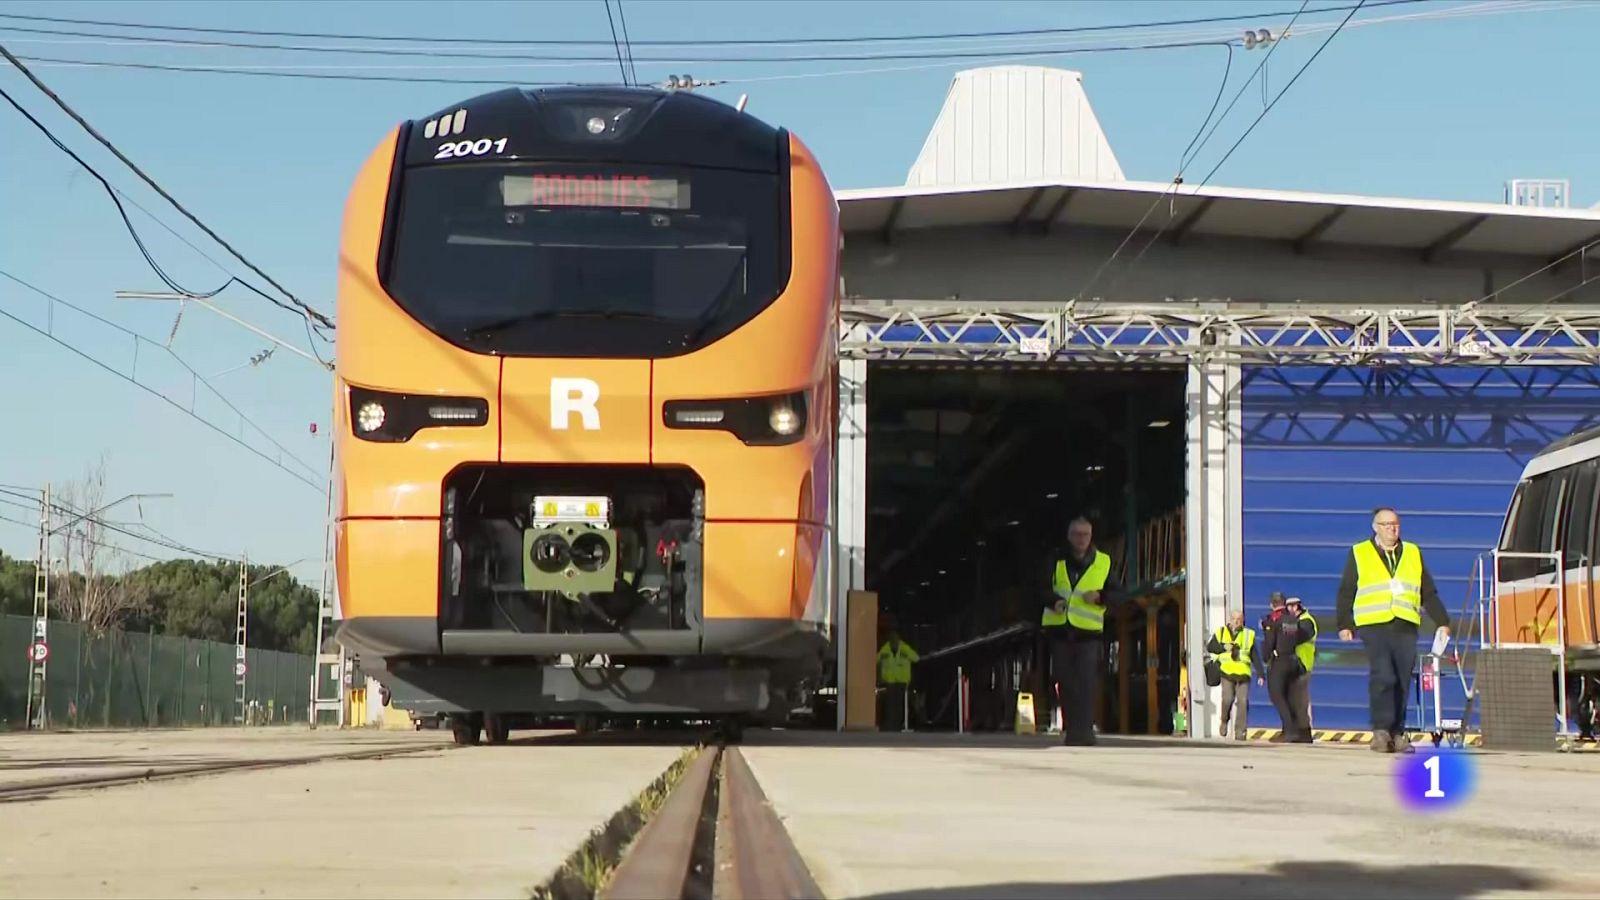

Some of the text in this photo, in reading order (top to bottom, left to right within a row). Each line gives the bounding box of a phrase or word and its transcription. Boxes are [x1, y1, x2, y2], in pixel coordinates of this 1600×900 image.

[434, 137, 508, 160] 2001
[532, 174, 651, 208] RODALIES
[550, 377, 601, 430] R
